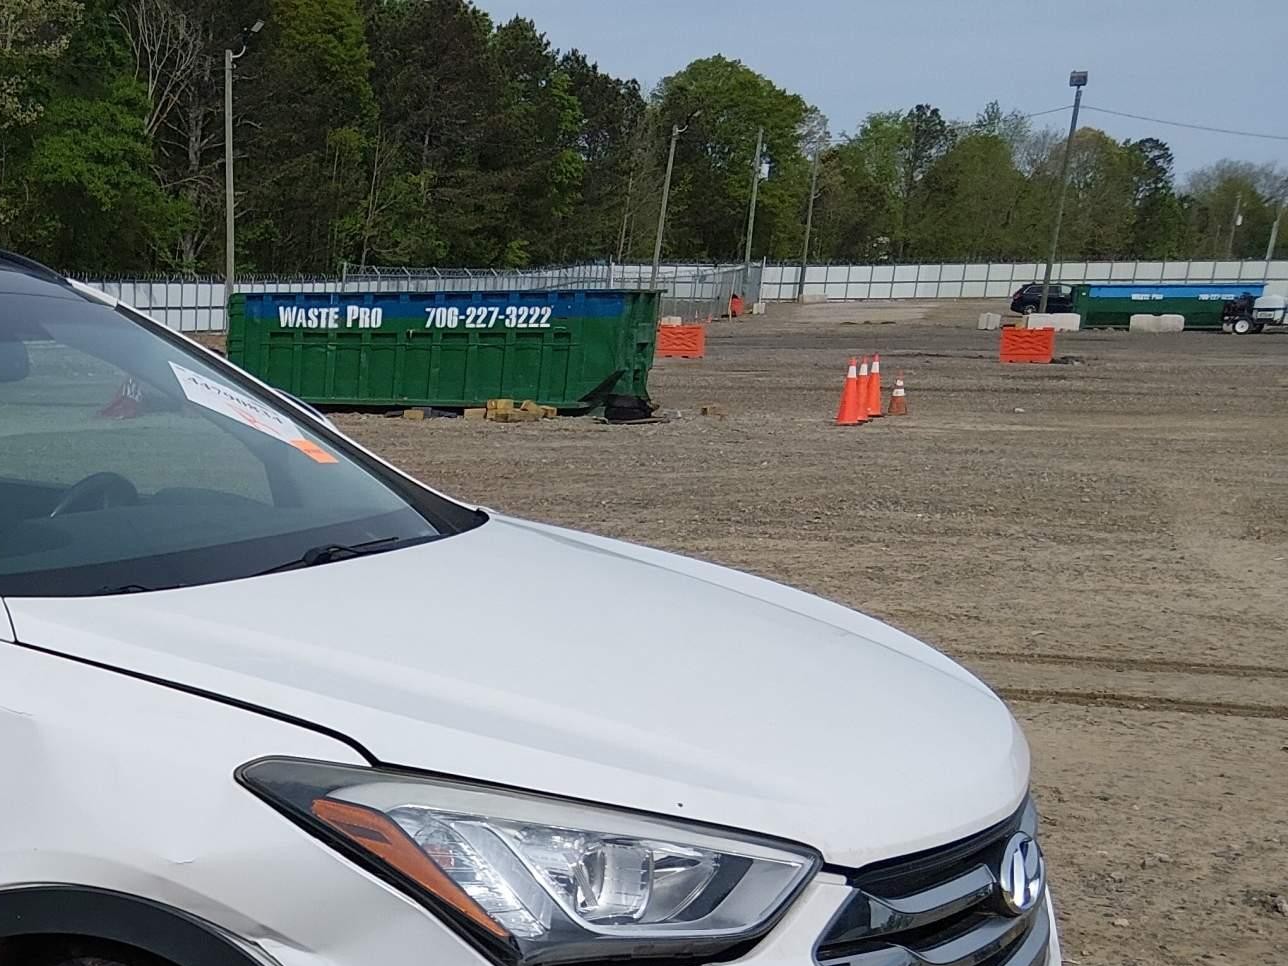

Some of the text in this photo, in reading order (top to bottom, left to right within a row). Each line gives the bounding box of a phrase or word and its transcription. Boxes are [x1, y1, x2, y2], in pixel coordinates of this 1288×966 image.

[278, 305, 552, 329] WASTE PRO 706-227-3222
